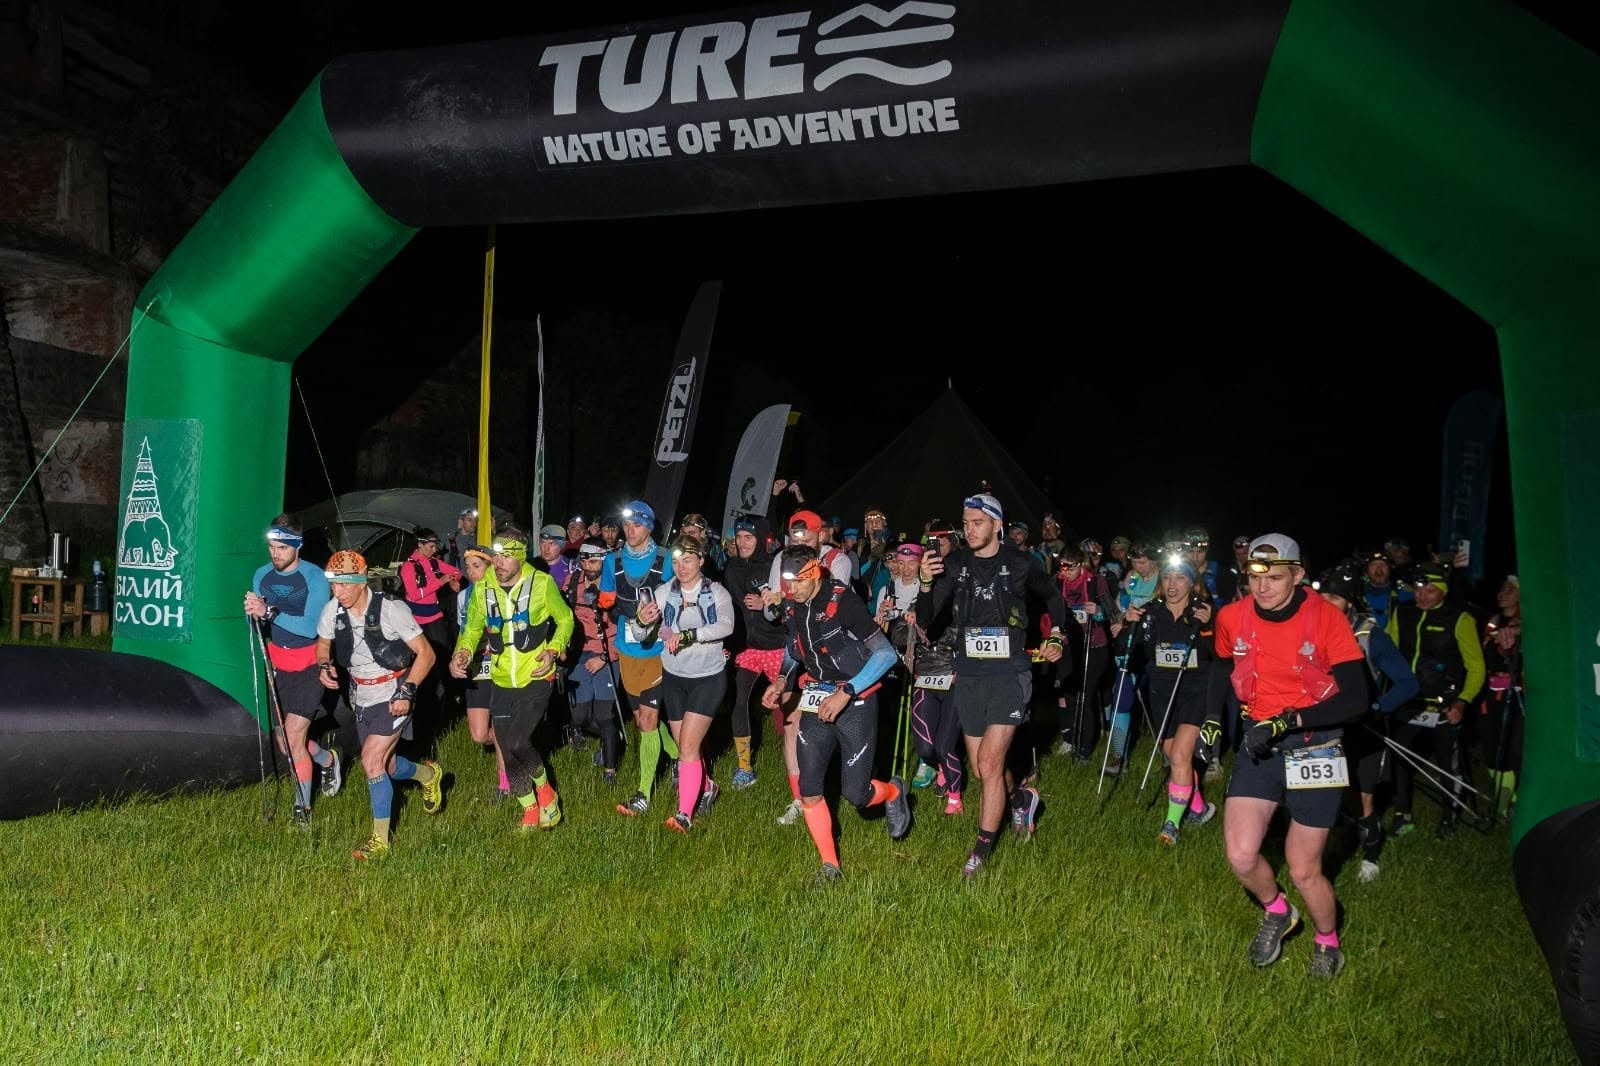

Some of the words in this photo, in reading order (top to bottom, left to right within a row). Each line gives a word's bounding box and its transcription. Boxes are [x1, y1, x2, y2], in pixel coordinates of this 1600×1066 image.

[538, 11, 812, 116] TURE
[542, 125, 672, 165] NATURE
[676, 120, 731, 155] OF
[729, 97, 960, 151] ADVENTURE
[656, 356, 697, 462] PETZL
[115, 601, 184, 628] СЛОН
[975, 640, 998, 652] 021
[924, 676, 944, 686] 016
[808, 694, 822, 707] 06
[1300, 763, 1334, 780] 053
